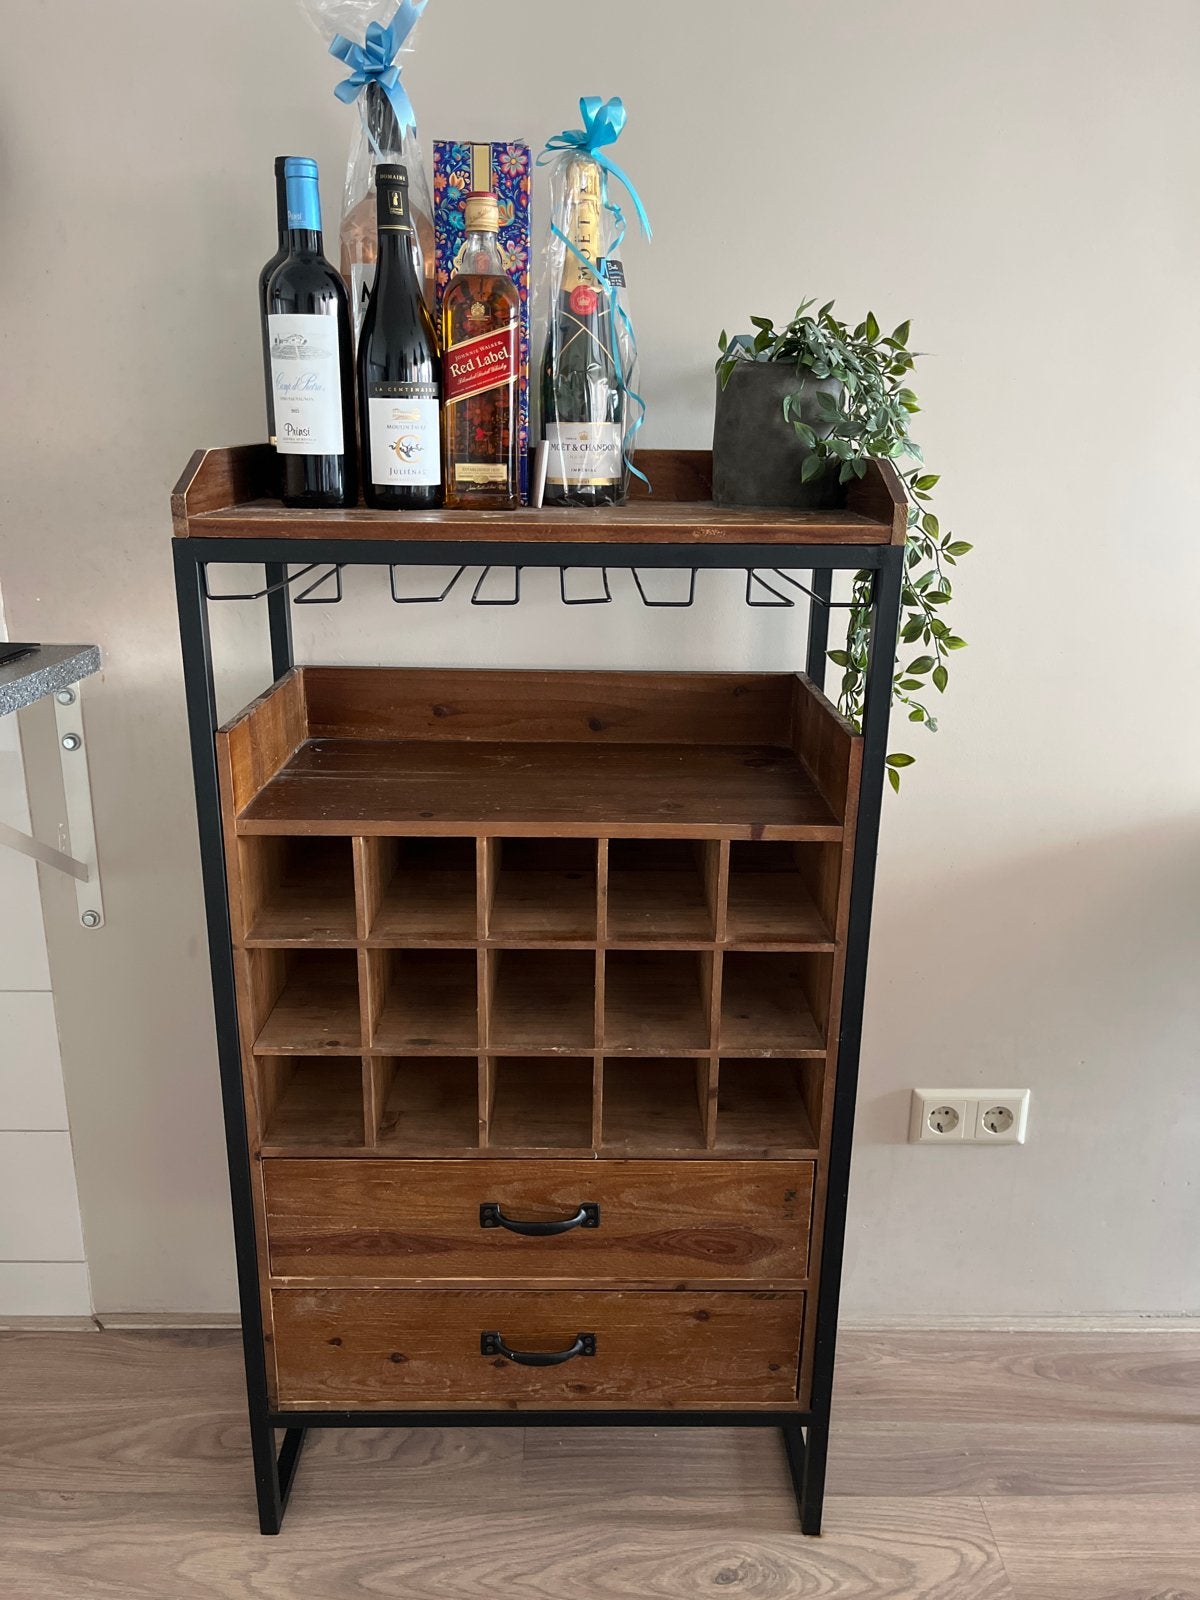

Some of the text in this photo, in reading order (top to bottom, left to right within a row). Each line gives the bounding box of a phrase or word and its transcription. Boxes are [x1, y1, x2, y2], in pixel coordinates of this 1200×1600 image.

[455, 348, 479, 362] JOHNNIE
[449, 358, 475, 378] Red
[284, 422, 311, 437] Prinsi
[572, 443, 578, 452] &
